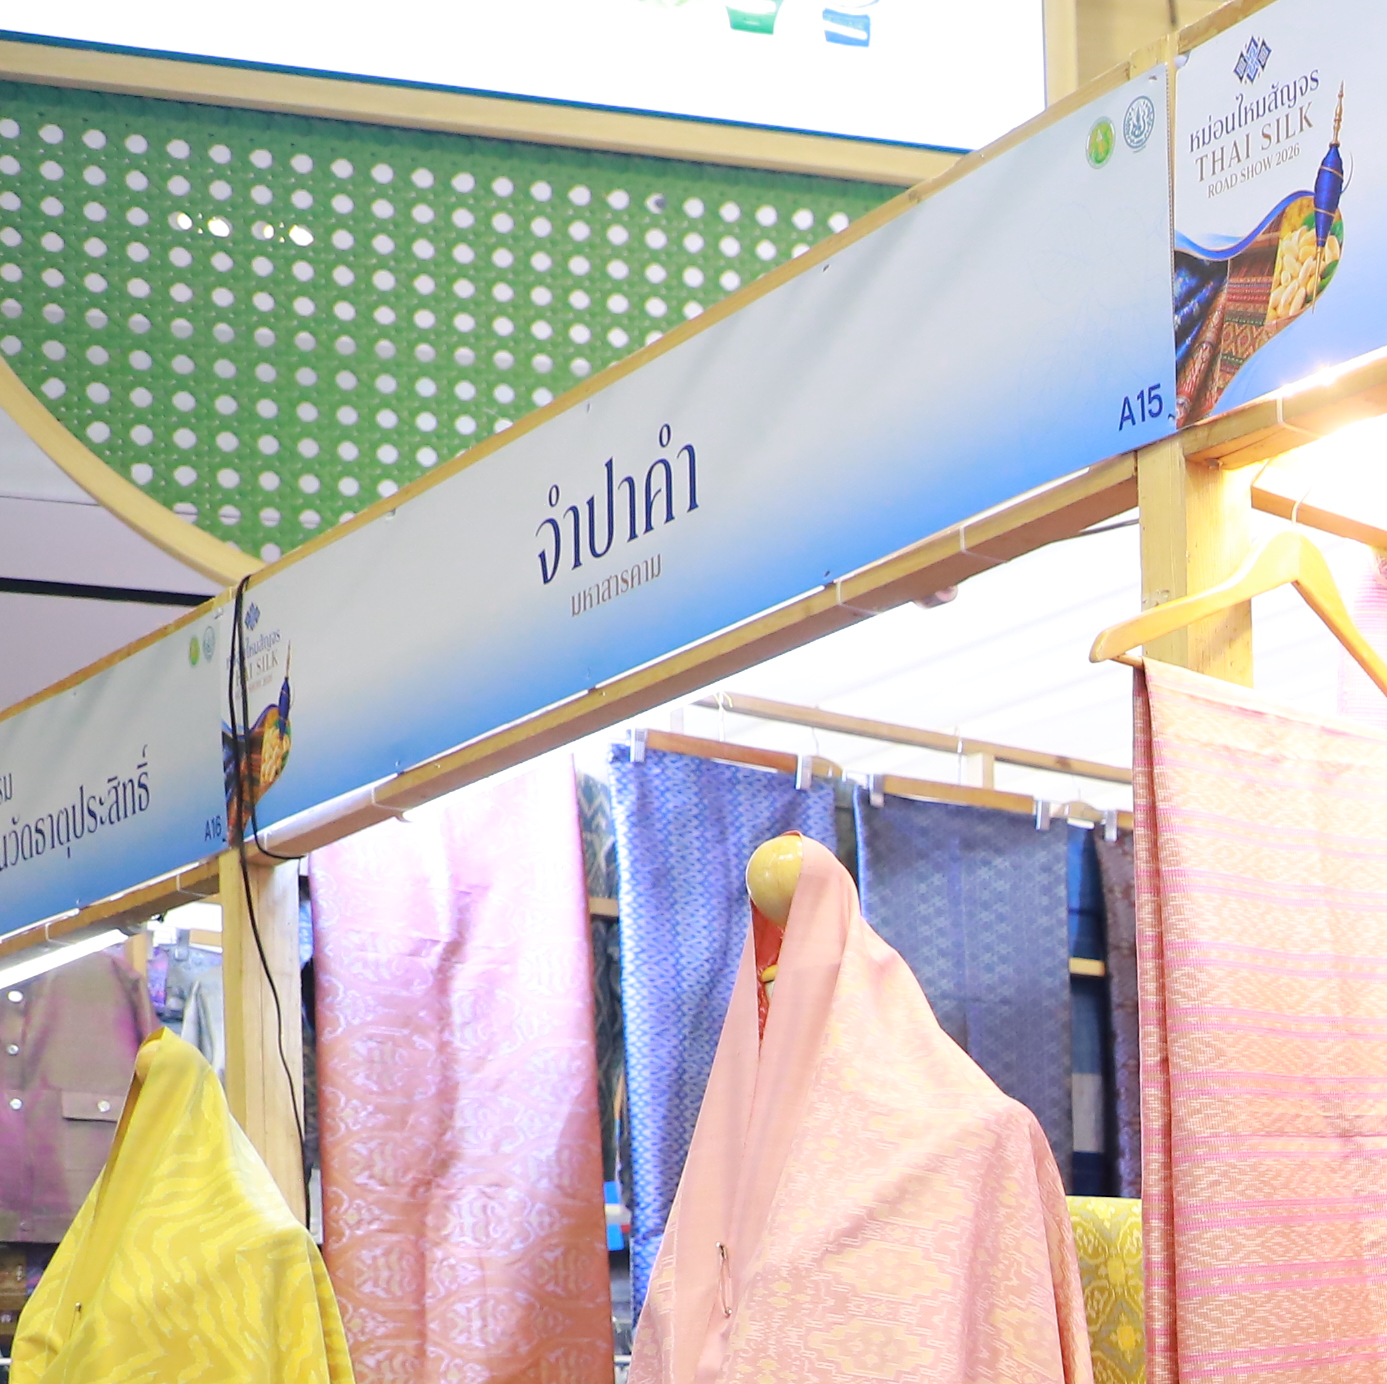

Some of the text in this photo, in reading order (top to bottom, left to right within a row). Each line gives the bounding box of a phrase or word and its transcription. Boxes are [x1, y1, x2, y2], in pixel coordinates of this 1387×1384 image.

[1189, 69, 1320, 154] หม่อนไหมสัญจร
[1195, 101, 1314, 183] THAI SILK
[1207, 142, 1300, 199] ROAD SHOW 2026
[1119, 383, 1163, 431] A15
[535, 423, 700, 585] จำปาคำ
[571, 553, 662, 617] มหาสารคาม
[204, 816, 222, 842] A16
